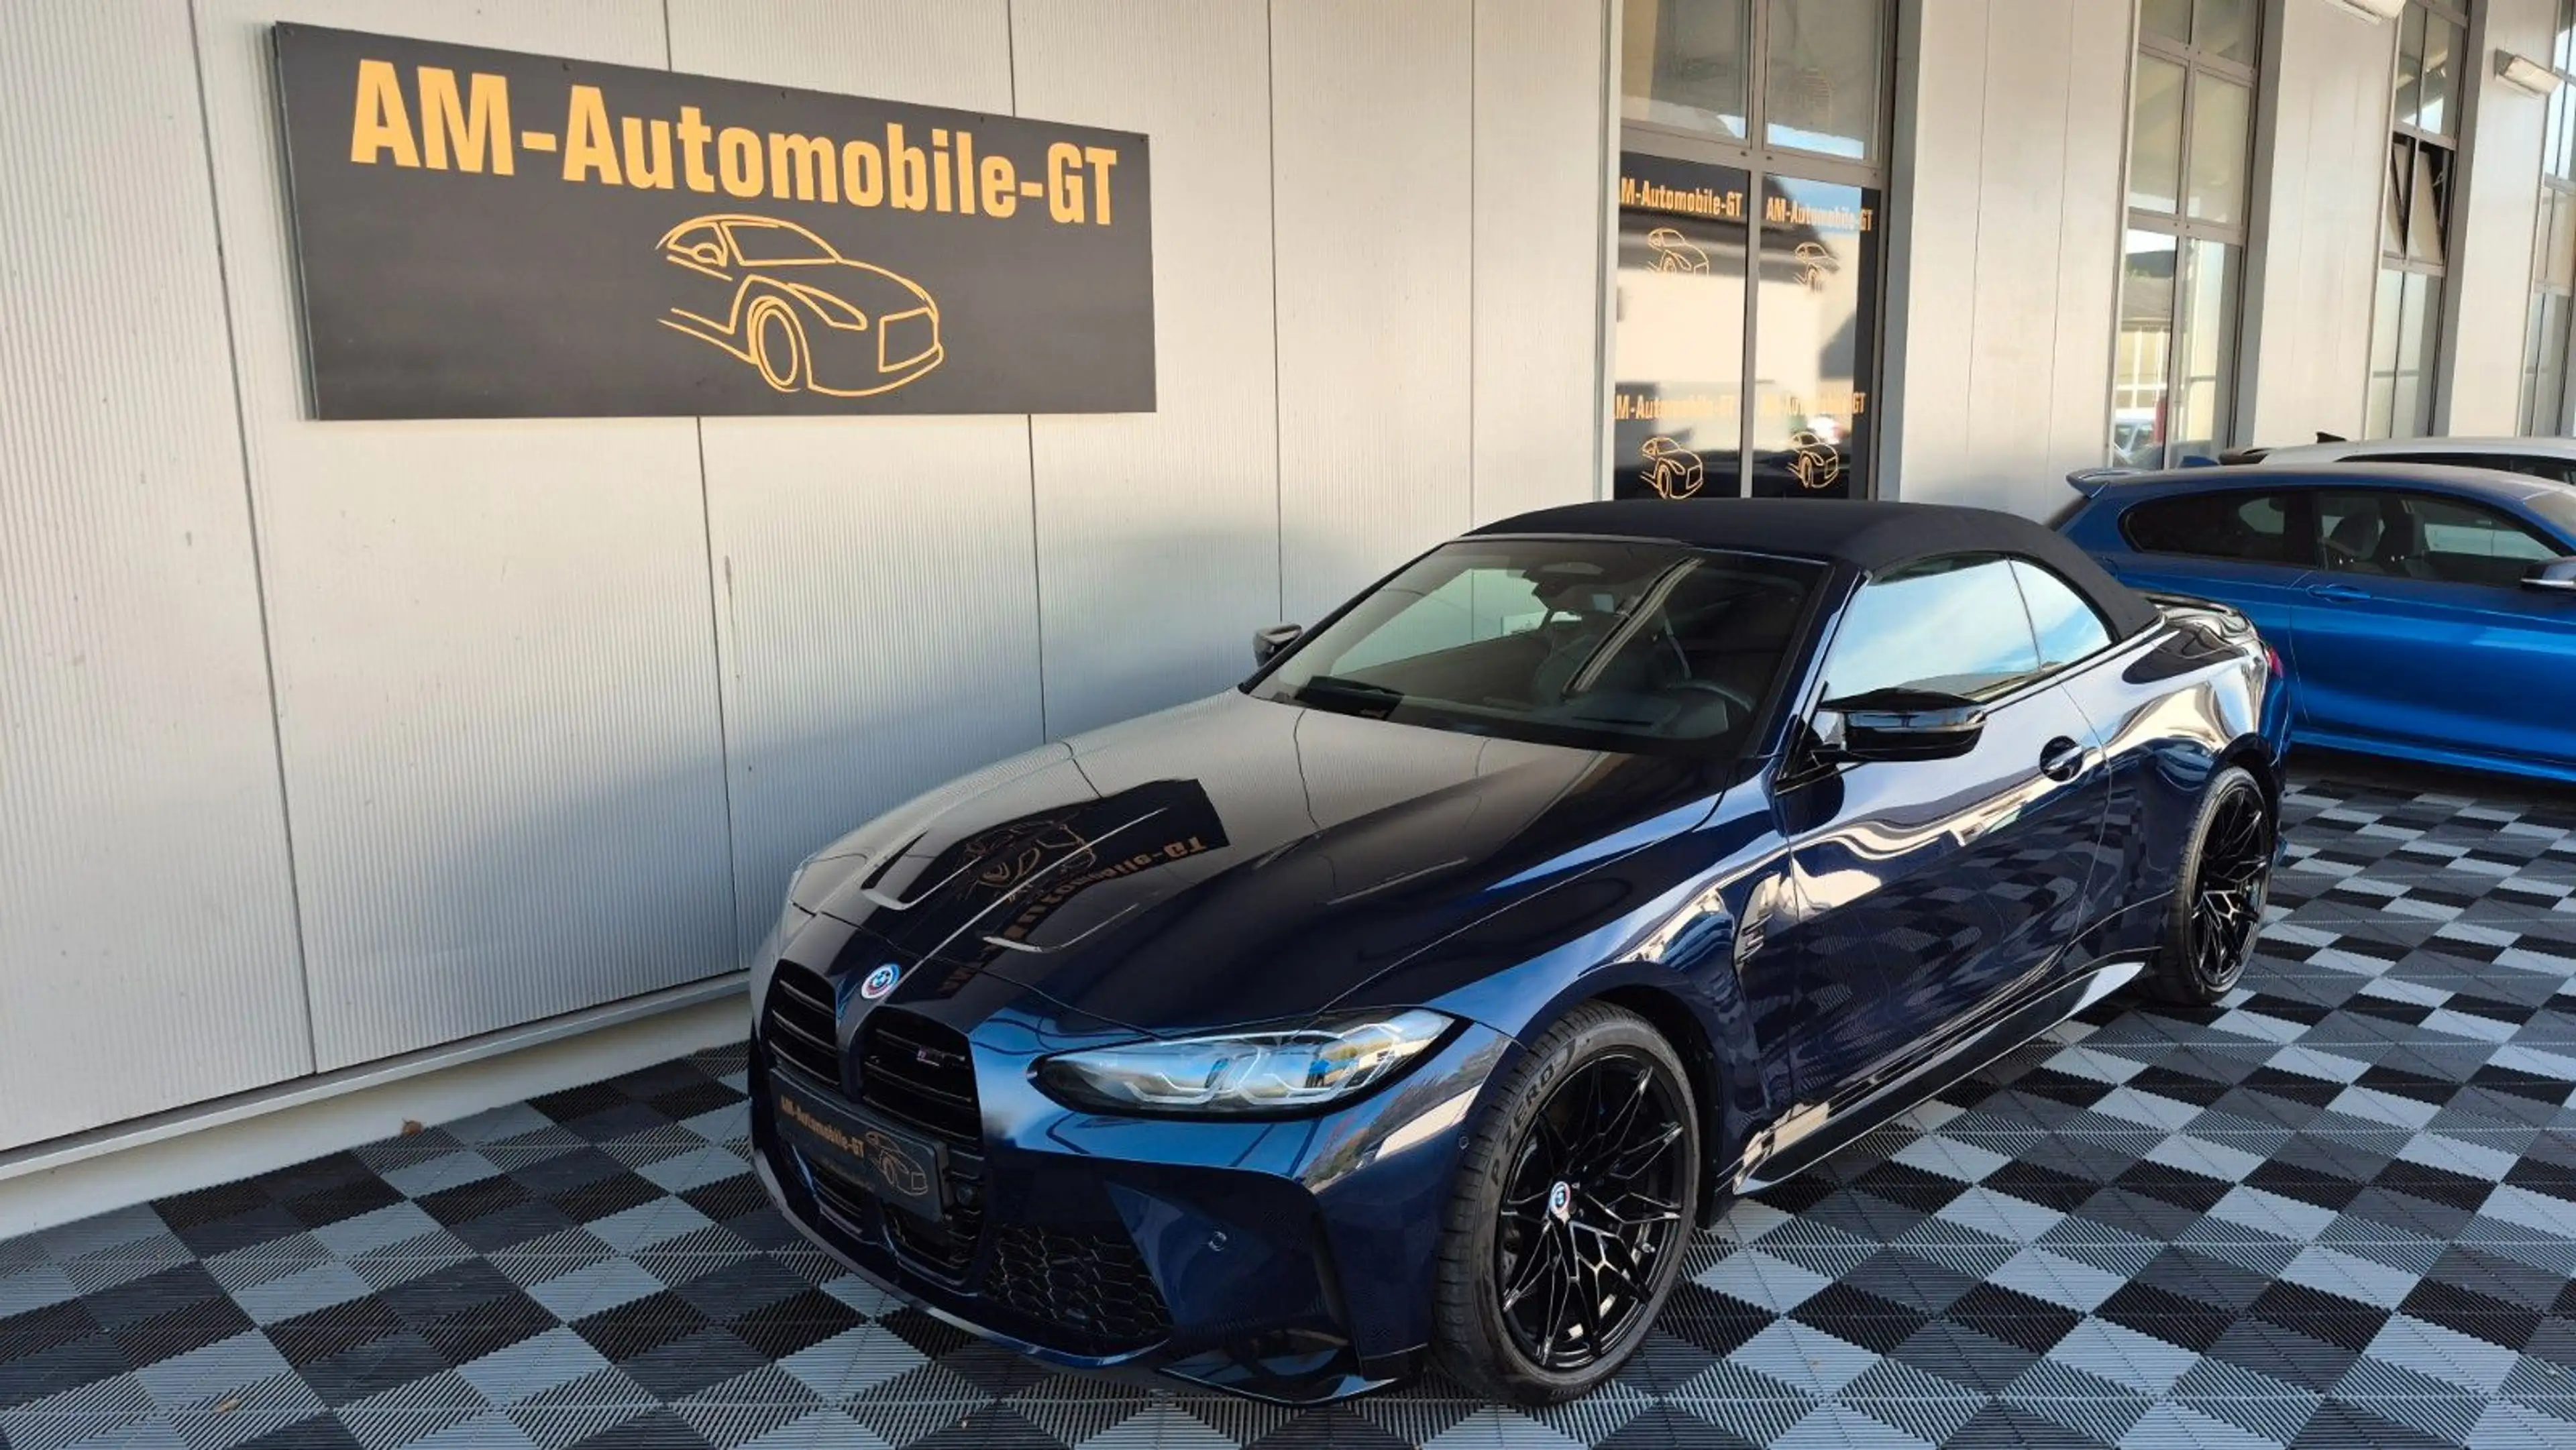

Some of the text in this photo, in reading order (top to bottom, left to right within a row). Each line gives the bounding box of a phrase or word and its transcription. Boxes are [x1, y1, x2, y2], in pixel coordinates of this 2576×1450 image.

[351, 59, 1117, 225] AM-Automobile-GT
[1619, 176, 1743, 218] M-Automobile-GT
[1491, 1063, 1555, 1186] P ZERO
